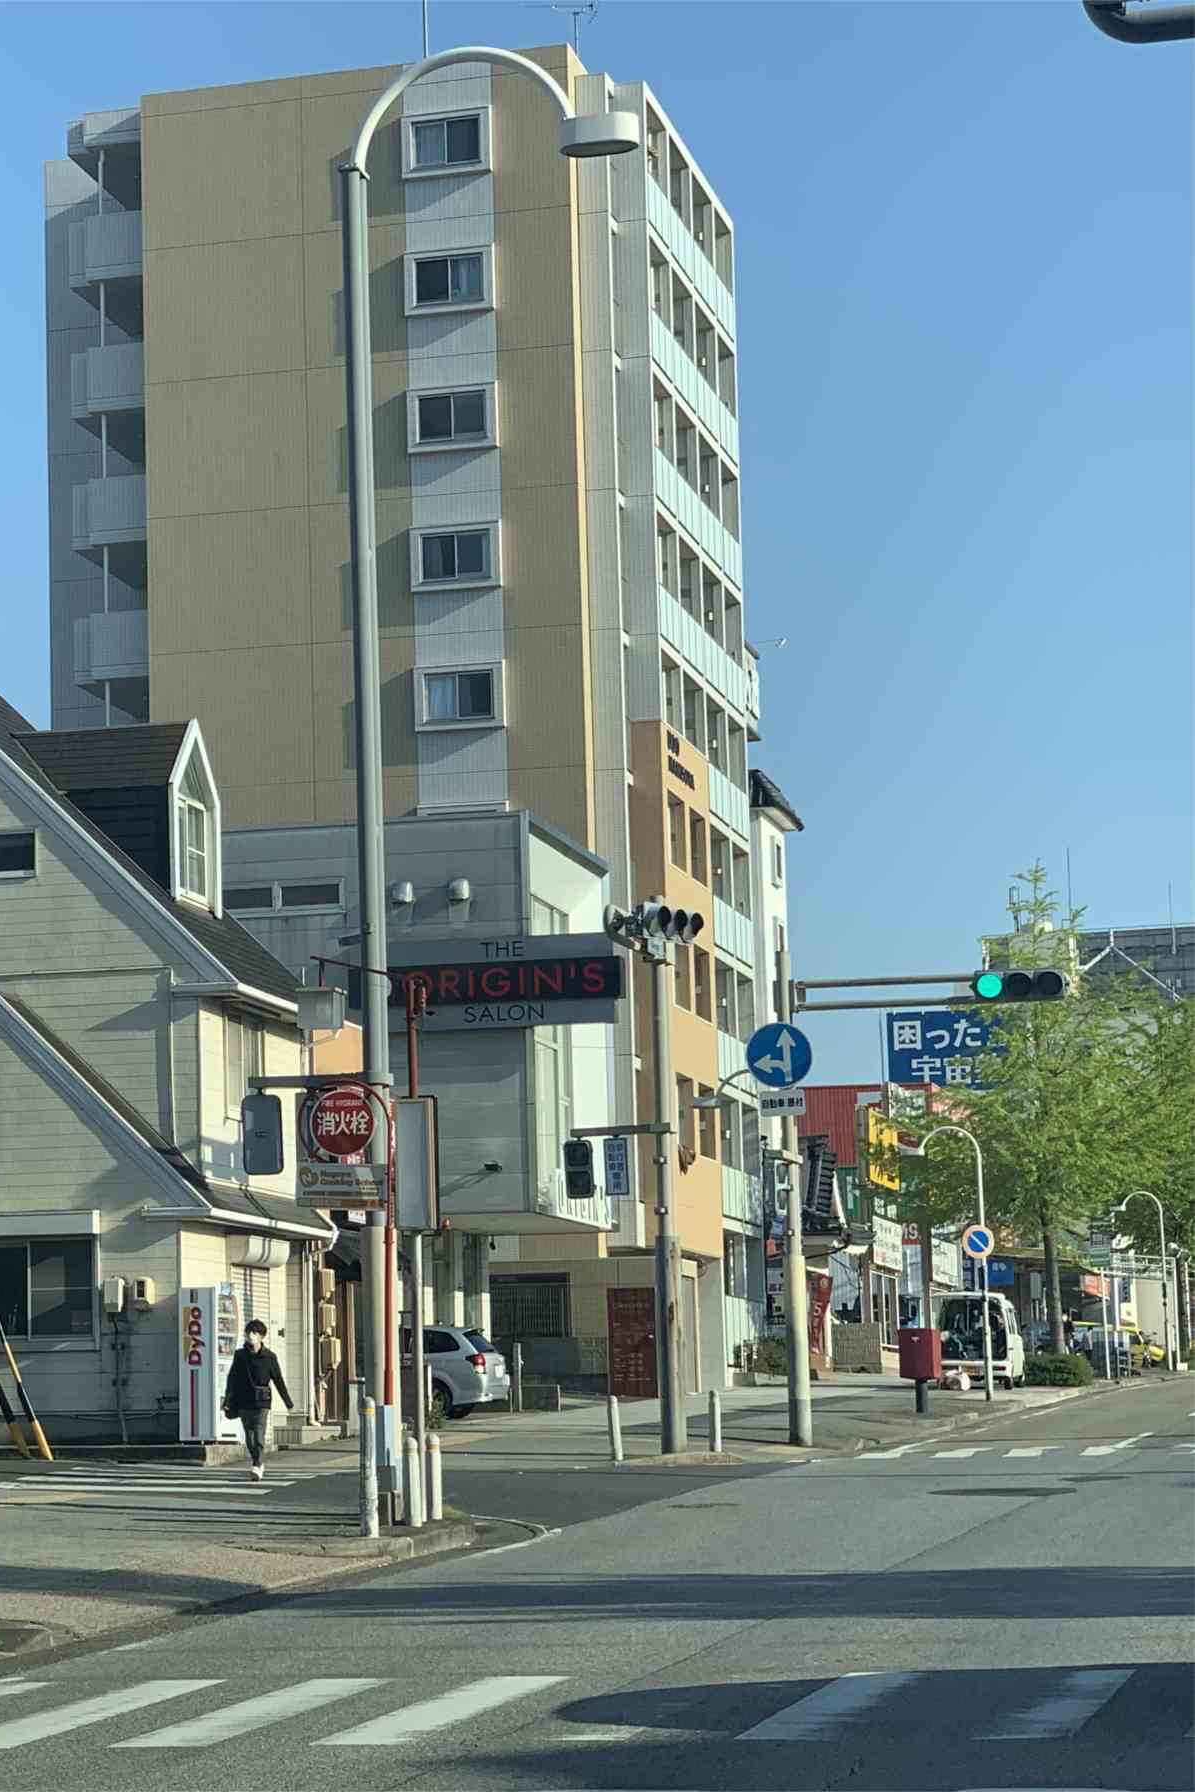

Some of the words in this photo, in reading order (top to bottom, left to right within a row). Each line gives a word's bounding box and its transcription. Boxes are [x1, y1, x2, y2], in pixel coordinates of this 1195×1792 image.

[480, 940, 526, 959] THE
[463, 1003, 545, 1024] SALON
[892, 1018, 1006, 1051] 困った
[317, 1110, 370, 1136] 消火栓
[188, 1306, 206, 1366] DyDo
